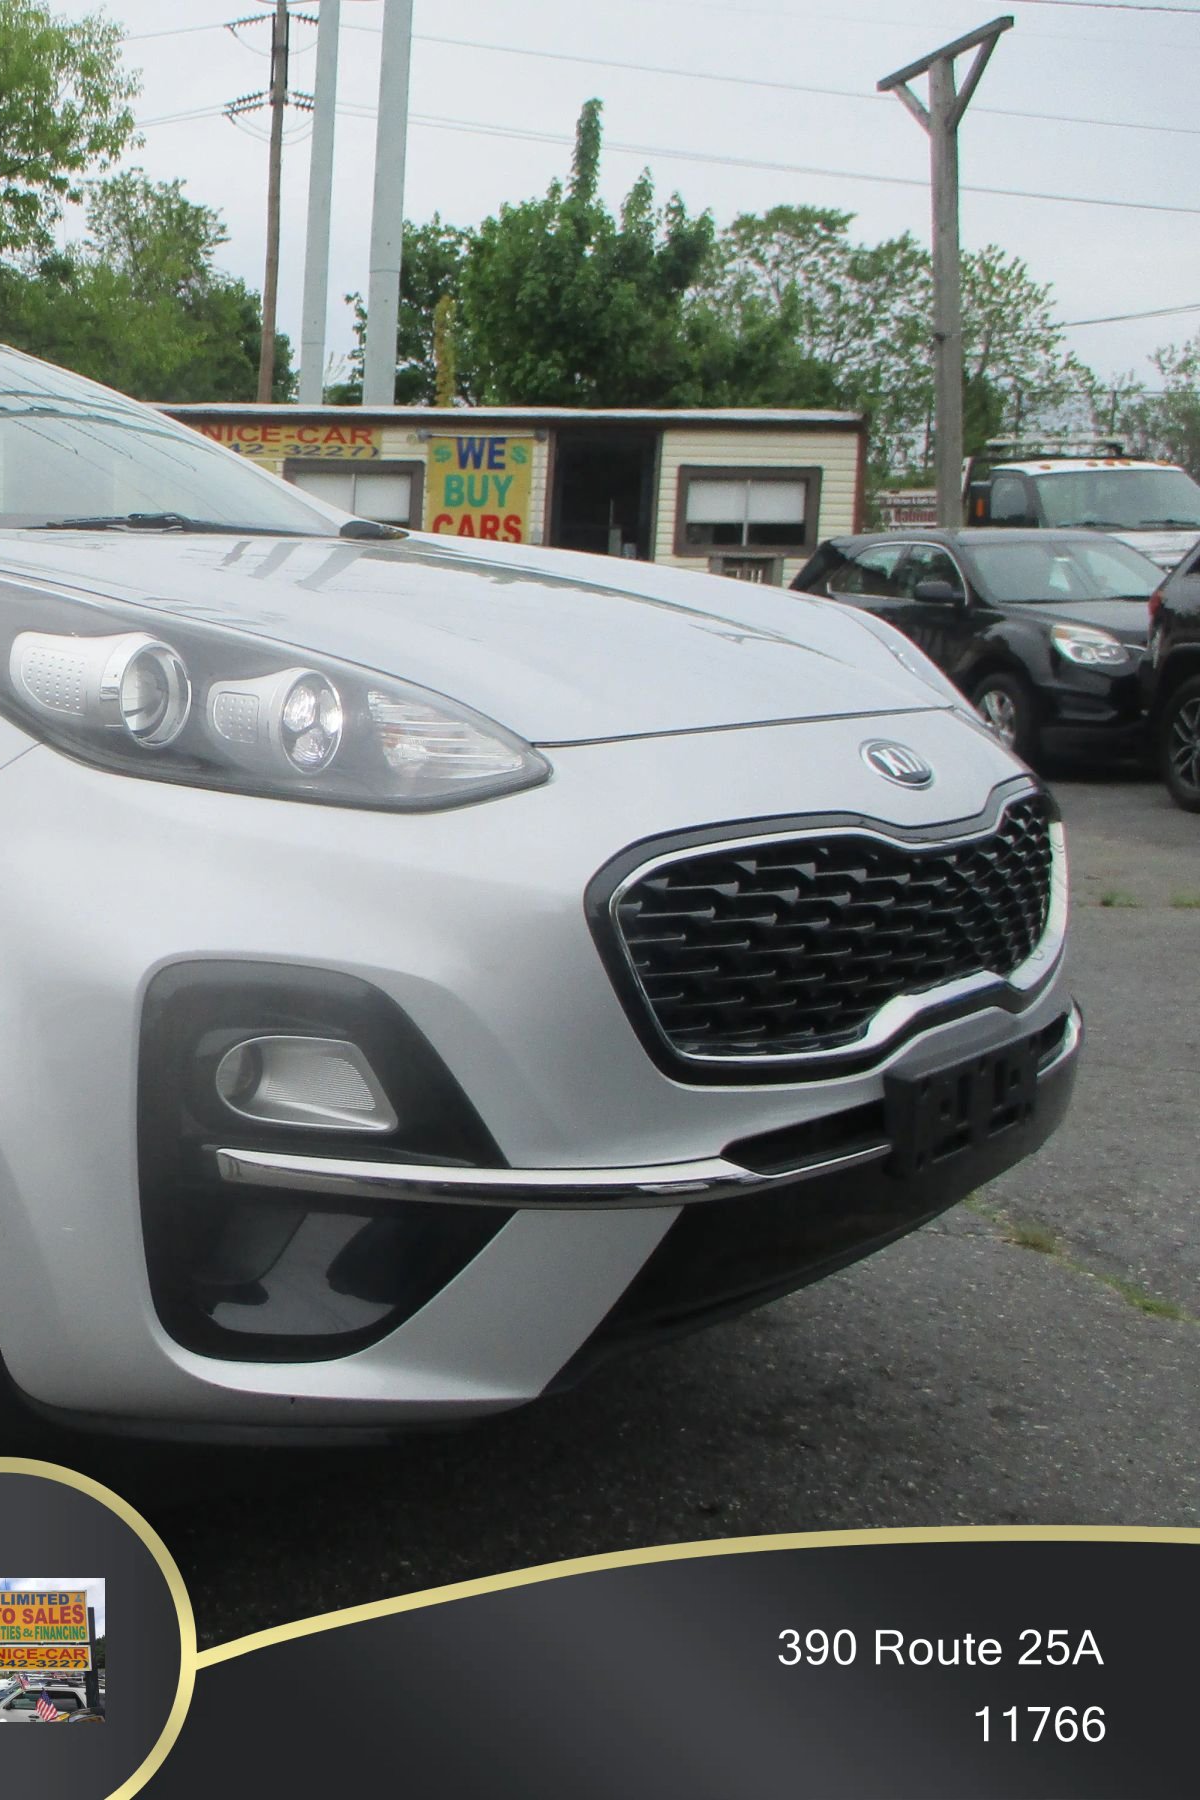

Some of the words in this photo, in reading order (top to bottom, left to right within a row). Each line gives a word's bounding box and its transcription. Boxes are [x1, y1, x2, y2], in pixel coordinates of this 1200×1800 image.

[456, 436, 507, 470] WE
[444, 474, 513, 508] BUY
[432, 513, 522, 543] CARS
